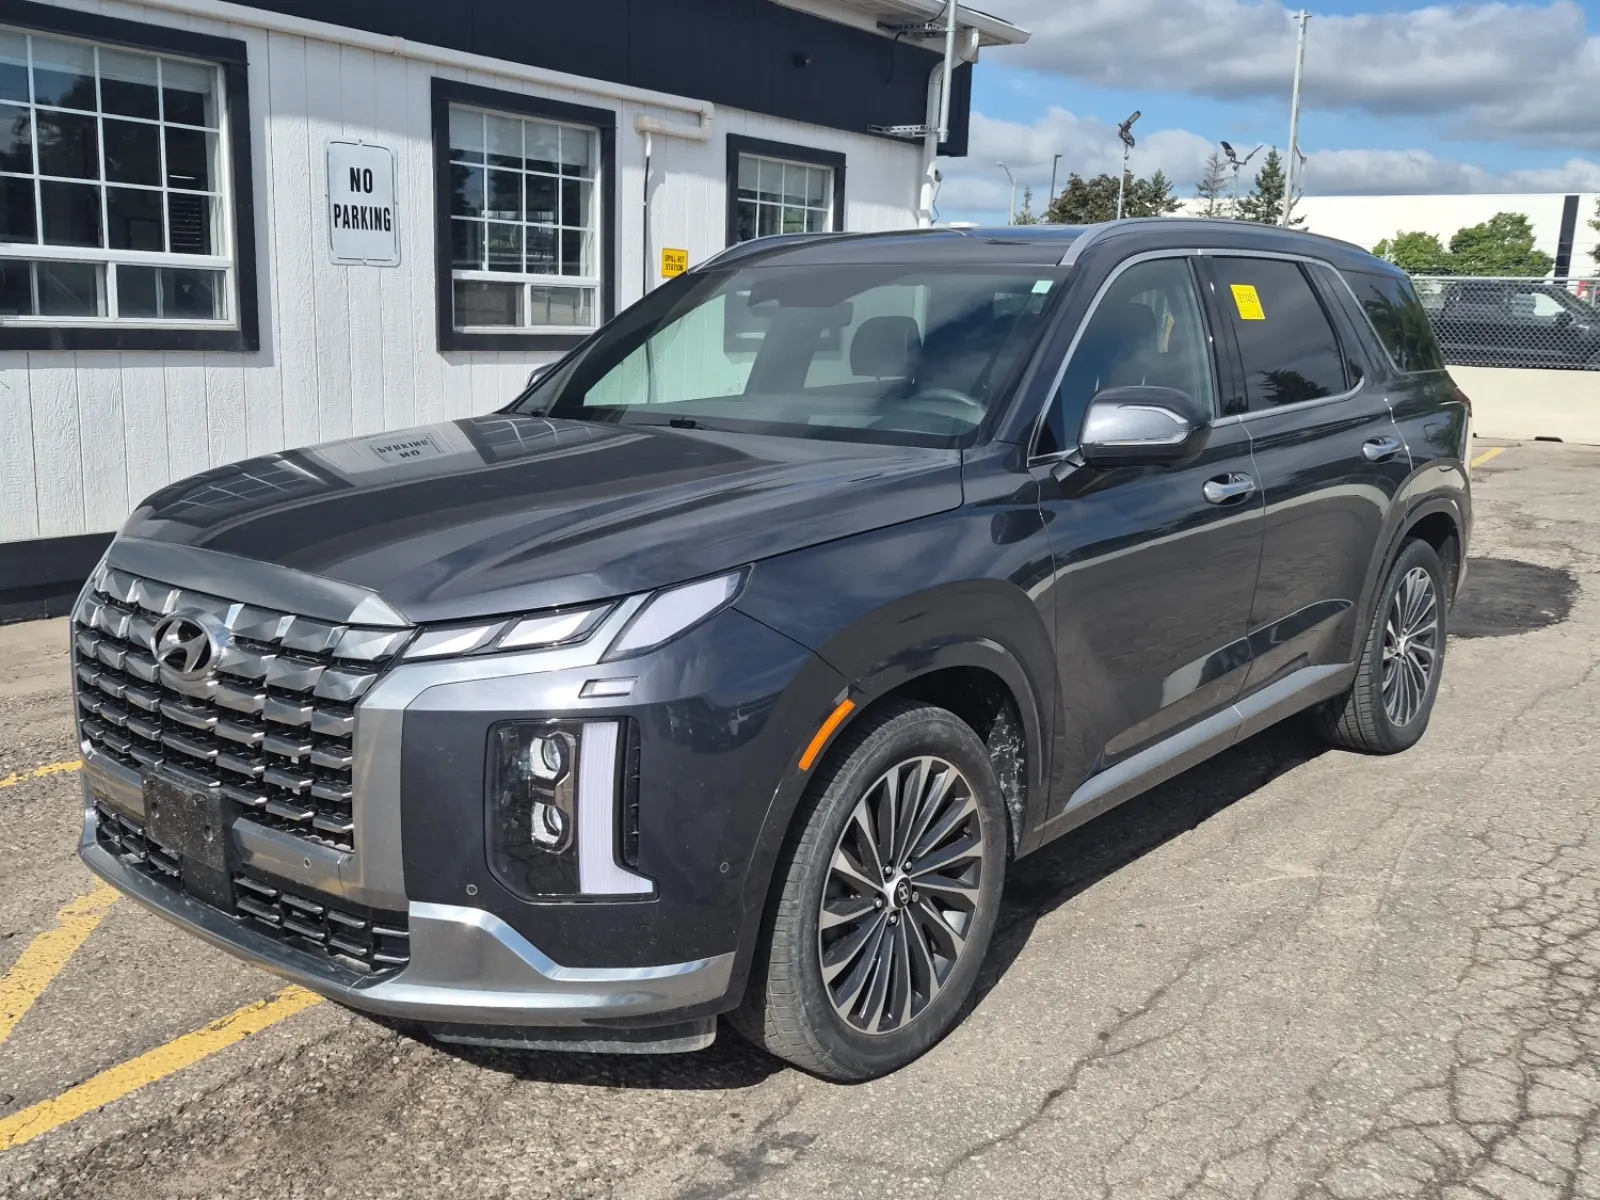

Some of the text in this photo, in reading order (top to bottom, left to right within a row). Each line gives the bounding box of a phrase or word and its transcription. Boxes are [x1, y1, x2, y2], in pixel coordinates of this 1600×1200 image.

[349, 166, 373, 194] NO
[333, 203, 391, 232] PARKING
[664, 254, 676, 263] SPILL
[665, 263, 684, 271] STATION
